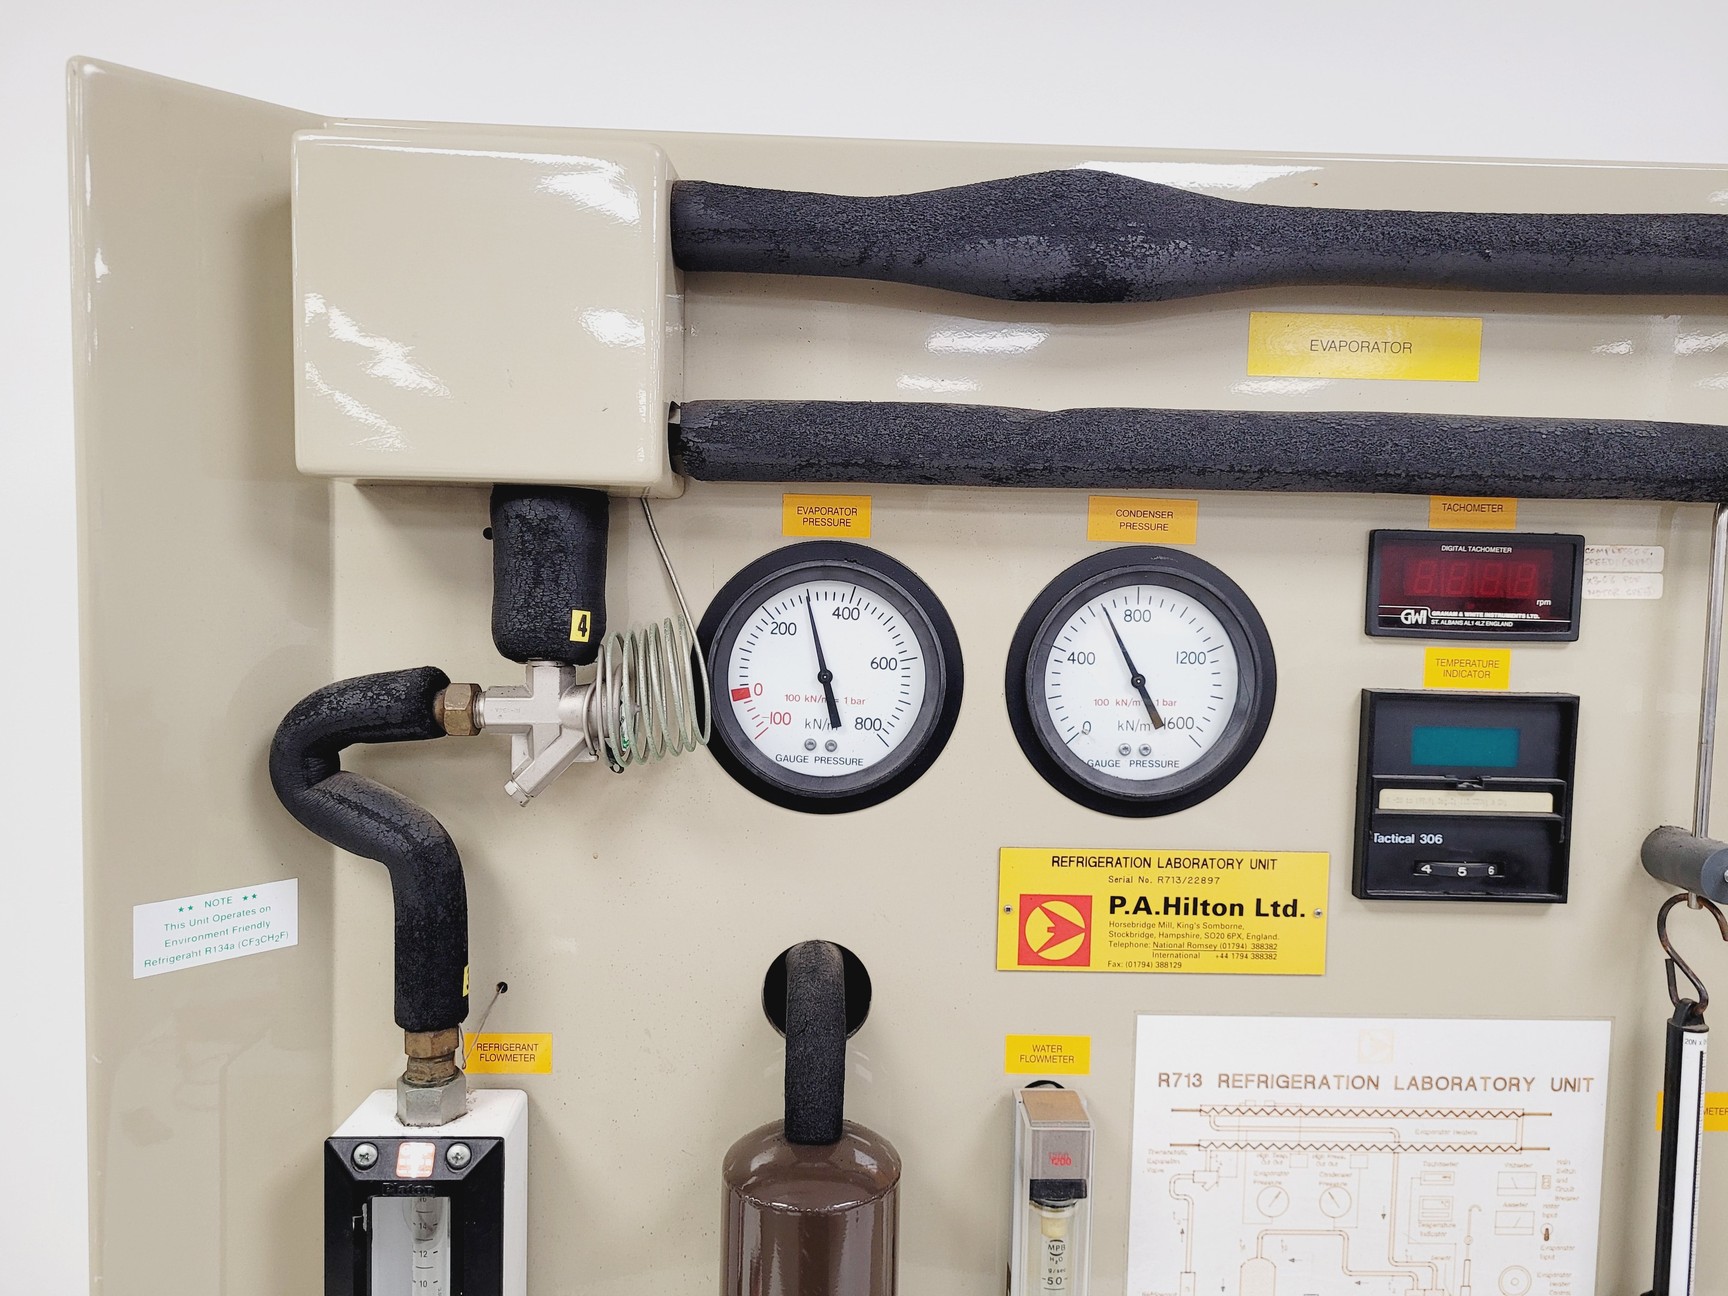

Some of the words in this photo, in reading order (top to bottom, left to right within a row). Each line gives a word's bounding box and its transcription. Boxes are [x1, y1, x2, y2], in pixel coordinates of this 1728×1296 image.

[1310, 339, 1412, 354] EVAPORATOR
[797, 506, 858, 517] EVAPORATOR
[1442, 503, 1504, 513] TACHOMETER
[1116, 509, 1174, 519] CONDENSER
[802, 517, 851, 527] PRESSURE
[1119, 522, 1169, 532] PRESSURE
[1441, 545, 1467, 553] DIGITAL
[1468, 546, 1512, 554] TACHOMETER
[1536, 599, 1552, 607] rpm
[832, 606, 860, 621] 400
[1123, 609, 1152, 623] 800
[1400, 609, 1428, 625] GWI
[578, 614, 587, 637] 4
[770, 621, 797, 636] 200
[1067, 652, 1096, 665] 400
[1176, 651, 1206, 665] 1200
[1436, 658, 1500, 668] TEMPERATURE
[870, 657, 898, 671] 600
[1443, 669, 1491, 679] INDICATOR
[754, 683, 763, 696] 0
[785, 694, 800, 702] 100
[851, 697, 866, 705] bar
[1094, 698, 1109, 706] 100
[1162, 698, 1177, 706] bar
[855, 717, 882, 731] 800
[1083, 721, 1091, 735] 0
[1164, 716, 1194, 730] 1600
[775, 753, 809, 763] GAUGE
[814, 756, 864, 766] PRESSURE
[1087, 759, 1121, 768] GAUGE
[1129, 760, 1180, 768] PRESSURE
[1373, 833, 1415, 844] Tactical
[1419, 834, 1443, 844] 306
[1051, 855, 1152, 869] REFRIGERATION
[1157, 857, 1244, 870] LABORATORY
[1250, 858, 1278, 870] UNIT
[1421, 864, 1432, 874] 4
[1457, 866, 1468, 877] 5
[1487, 866, 1495, 875] 6
[1108, 875, 1134, 884] Serial
[1138, 876, 1152, 884] No.
[1157, 876, 1220, 885] R713/22897
[204, 896, 233, 908] NOTE
[1109, 895, 1244, 917] P.A.Hilton
[1255, 898, 1306, 918] Ltd.
[164, 922, 186, 932] This
[189, 916, 209, 927] Unit
[212, 908, 257, 923] Operates
[259, 905, 271, 914] on
[1108, 921, 1155, 931] Horsebridge
[1157, 921, 1175, 930] Mill,
[1176, 922, 1201, 932] King's
[1202, 922, 1245, 931] Somborne,
[164, 928, 229, 948] Environment
[232, 920, 271, 935] Friendly
[1108, 931, 1156, 941] Stockbridge,
[1158, 931, 1202, 941] Hampshire,
[1204, 932, 1225, 941] SO20
[1226, 932, 1244, 942] 6PX,
[1246, 933, 1280, 942] England.
[204, 943, 235, 956] R134a
[1108, 940, 1151, 950] Telephone:
[1152, 941, 1185, 950] National
[1186, 942, 1218, 952] Romsey
[1219, 942, 1248, 951] (01794)
[1250, 942, 1278, 951] 388382
[1152, 951, 1200, 960] International
[1230, 952, 1248, 960] 1794
[1250, 953, 1277, 961] 388382
[1107, 960, 1124, 968] Fax:
[1125, 961, 1153, 969] (01794)
[1155, 961, 1182, 969] 388129
[476, 1043, 539, 1052] REFRIGERANT
[1032, 1044, 1063, 1053] WATER
[479, 1054, 536, 1062] FLOWMETER
[1019, 1055, 1075, 1064] FLOWMETER
[1158, 1072, 1203, 1089] R713
[1217, 1073, 1380, 1091] REFRIGERATION
[1393, 1075, 1535, 1093] LABORATORY
[1550, 1077, 1595, 1094] UNIT
[419, 1250, 428, 1258] 12
[419, 1280, 428, 1288] 10
[1047, 1276, 1063, 1286] 50
